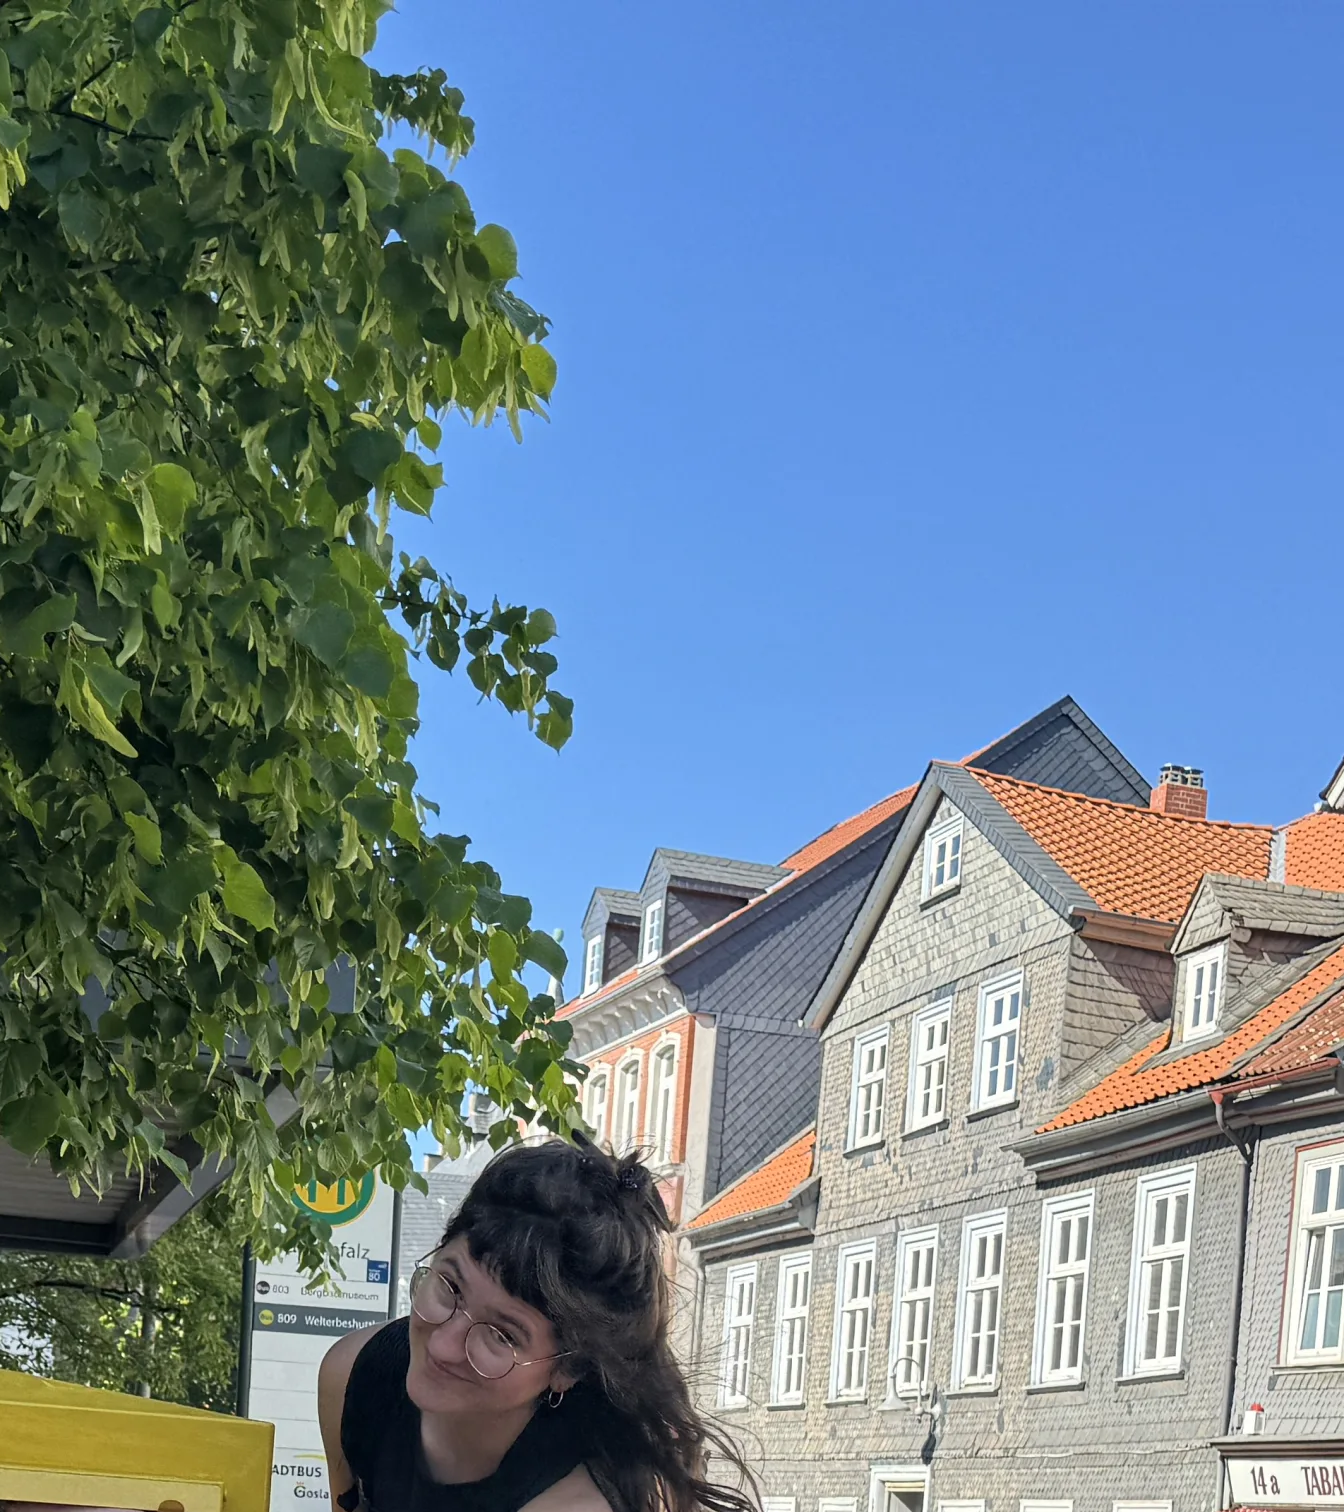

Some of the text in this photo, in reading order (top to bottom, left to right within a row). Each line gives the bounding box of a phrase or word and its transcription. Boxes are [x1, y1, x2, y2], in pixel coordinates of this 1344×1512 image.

[277, 1313, 297, 1324] 809
[272, 1464, 322, 1478] ADTBUS
[293, 1485, 330, 1499] Gosla
